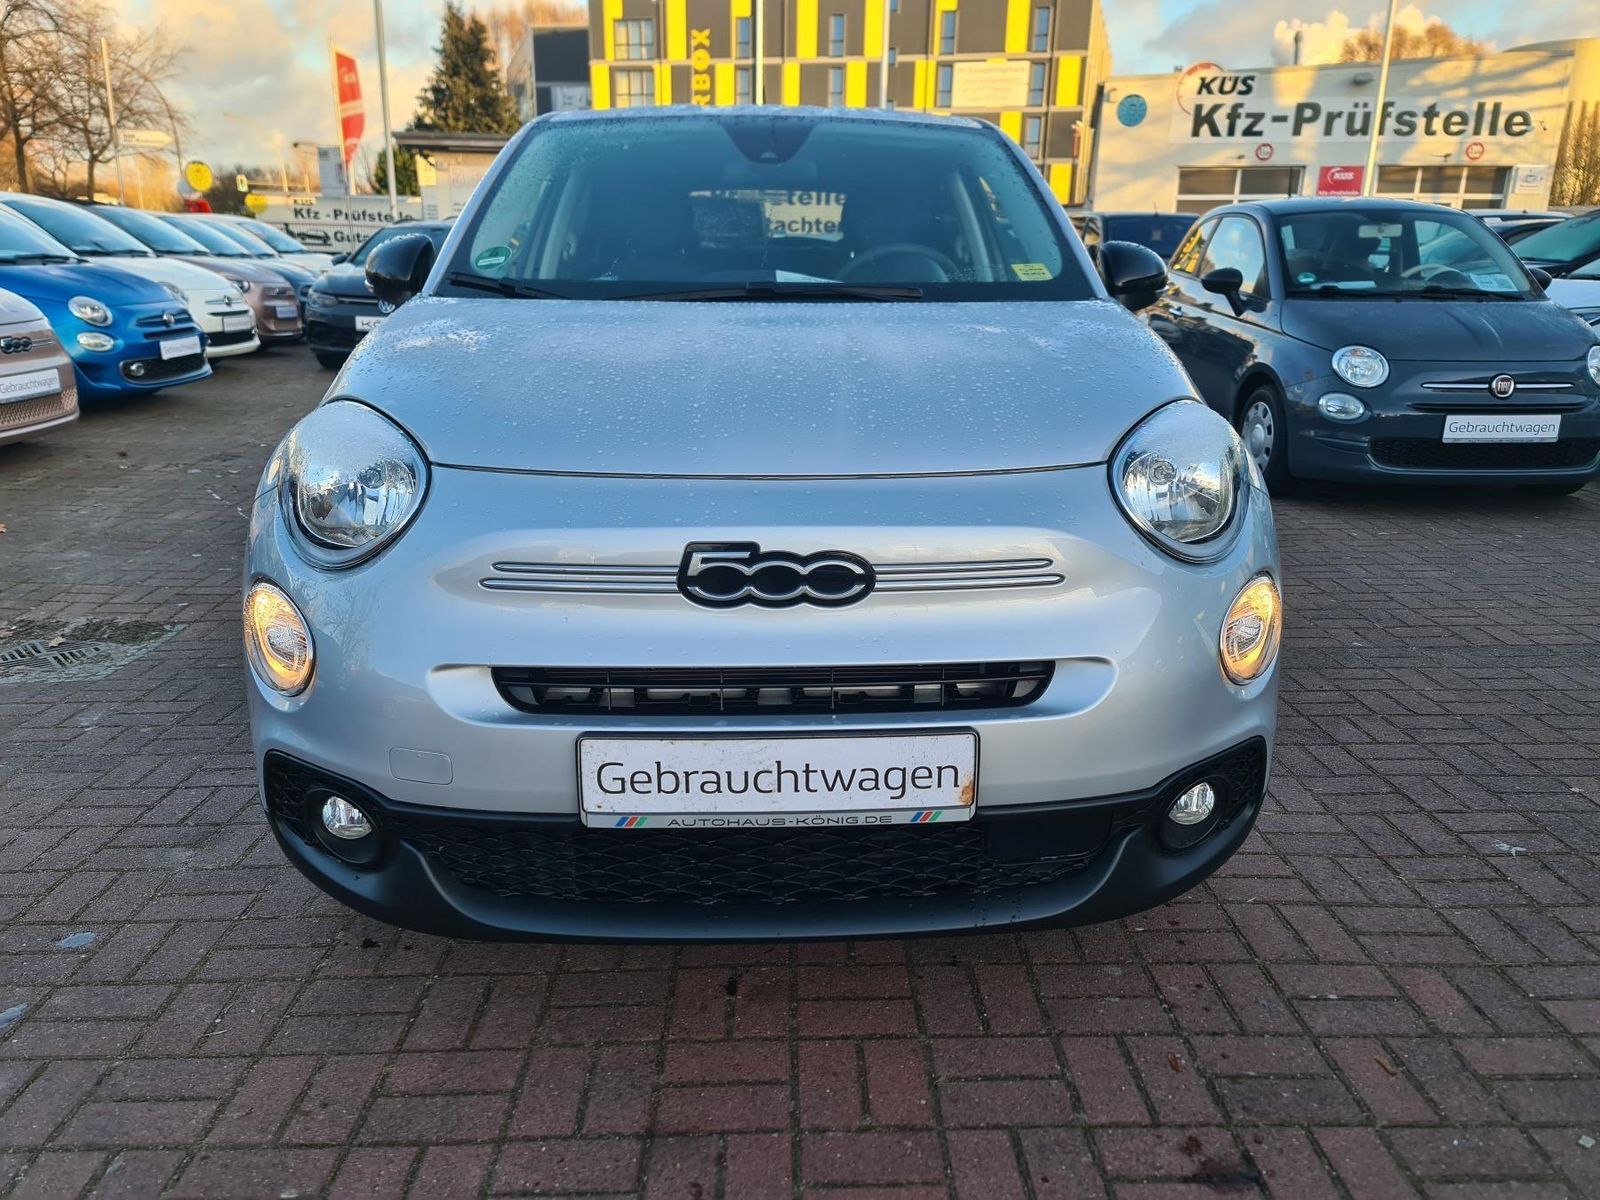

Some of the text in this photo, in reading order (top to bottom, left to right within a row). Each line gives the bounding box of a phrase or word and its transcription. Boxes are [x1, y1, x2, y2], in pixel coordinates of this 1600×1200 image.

[1197, 75, 1255, 95] KÜS
[1191, 102, 1532, 137] Kfz-Prüfstelle
[1497, 381, 1511, 391] FIAT
[1448, 421, 1556, 435] Gebrauchtwagen
[682, 547, 871, 603] 500
[596, 760, 960, 800] Gebrauchtwagen
[667, 814, 893, 827] AUTOHAUS-KÖNIG.DE
